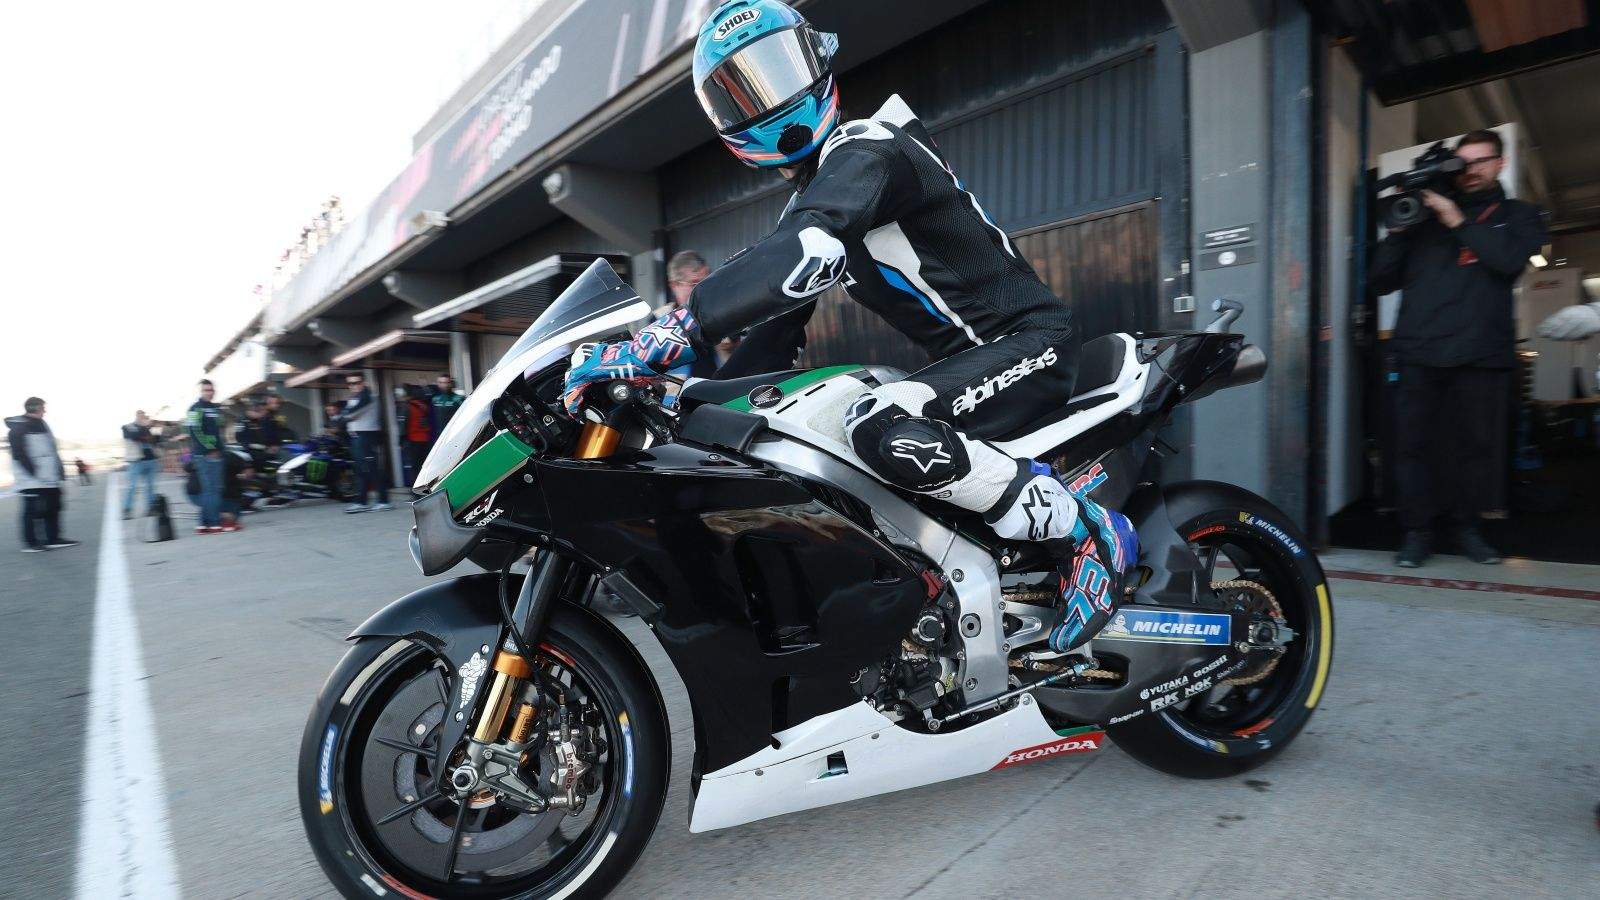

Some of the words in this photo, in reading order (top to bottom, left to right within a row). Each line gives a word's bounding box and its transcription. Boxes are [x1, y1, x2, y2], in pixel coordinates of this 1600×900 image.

[718, 10, 755, 36] SHOEI
[952, 347, 1057, 416] alpinestars
[1255, 519, 1301, 555] MICHELIN
[1132, 621, 1221, 636] MICHELIN
[1150, 675, 1189, 695] YUTAKA
[1193, 654, 1228, 678] GOSHI
[1150, 691, 1180, 713] RK
[1184, 676, 1212, 697] NGK
[1004, 740, 1098, 764] HONDA
[566, 752, 575, 790] brembo
